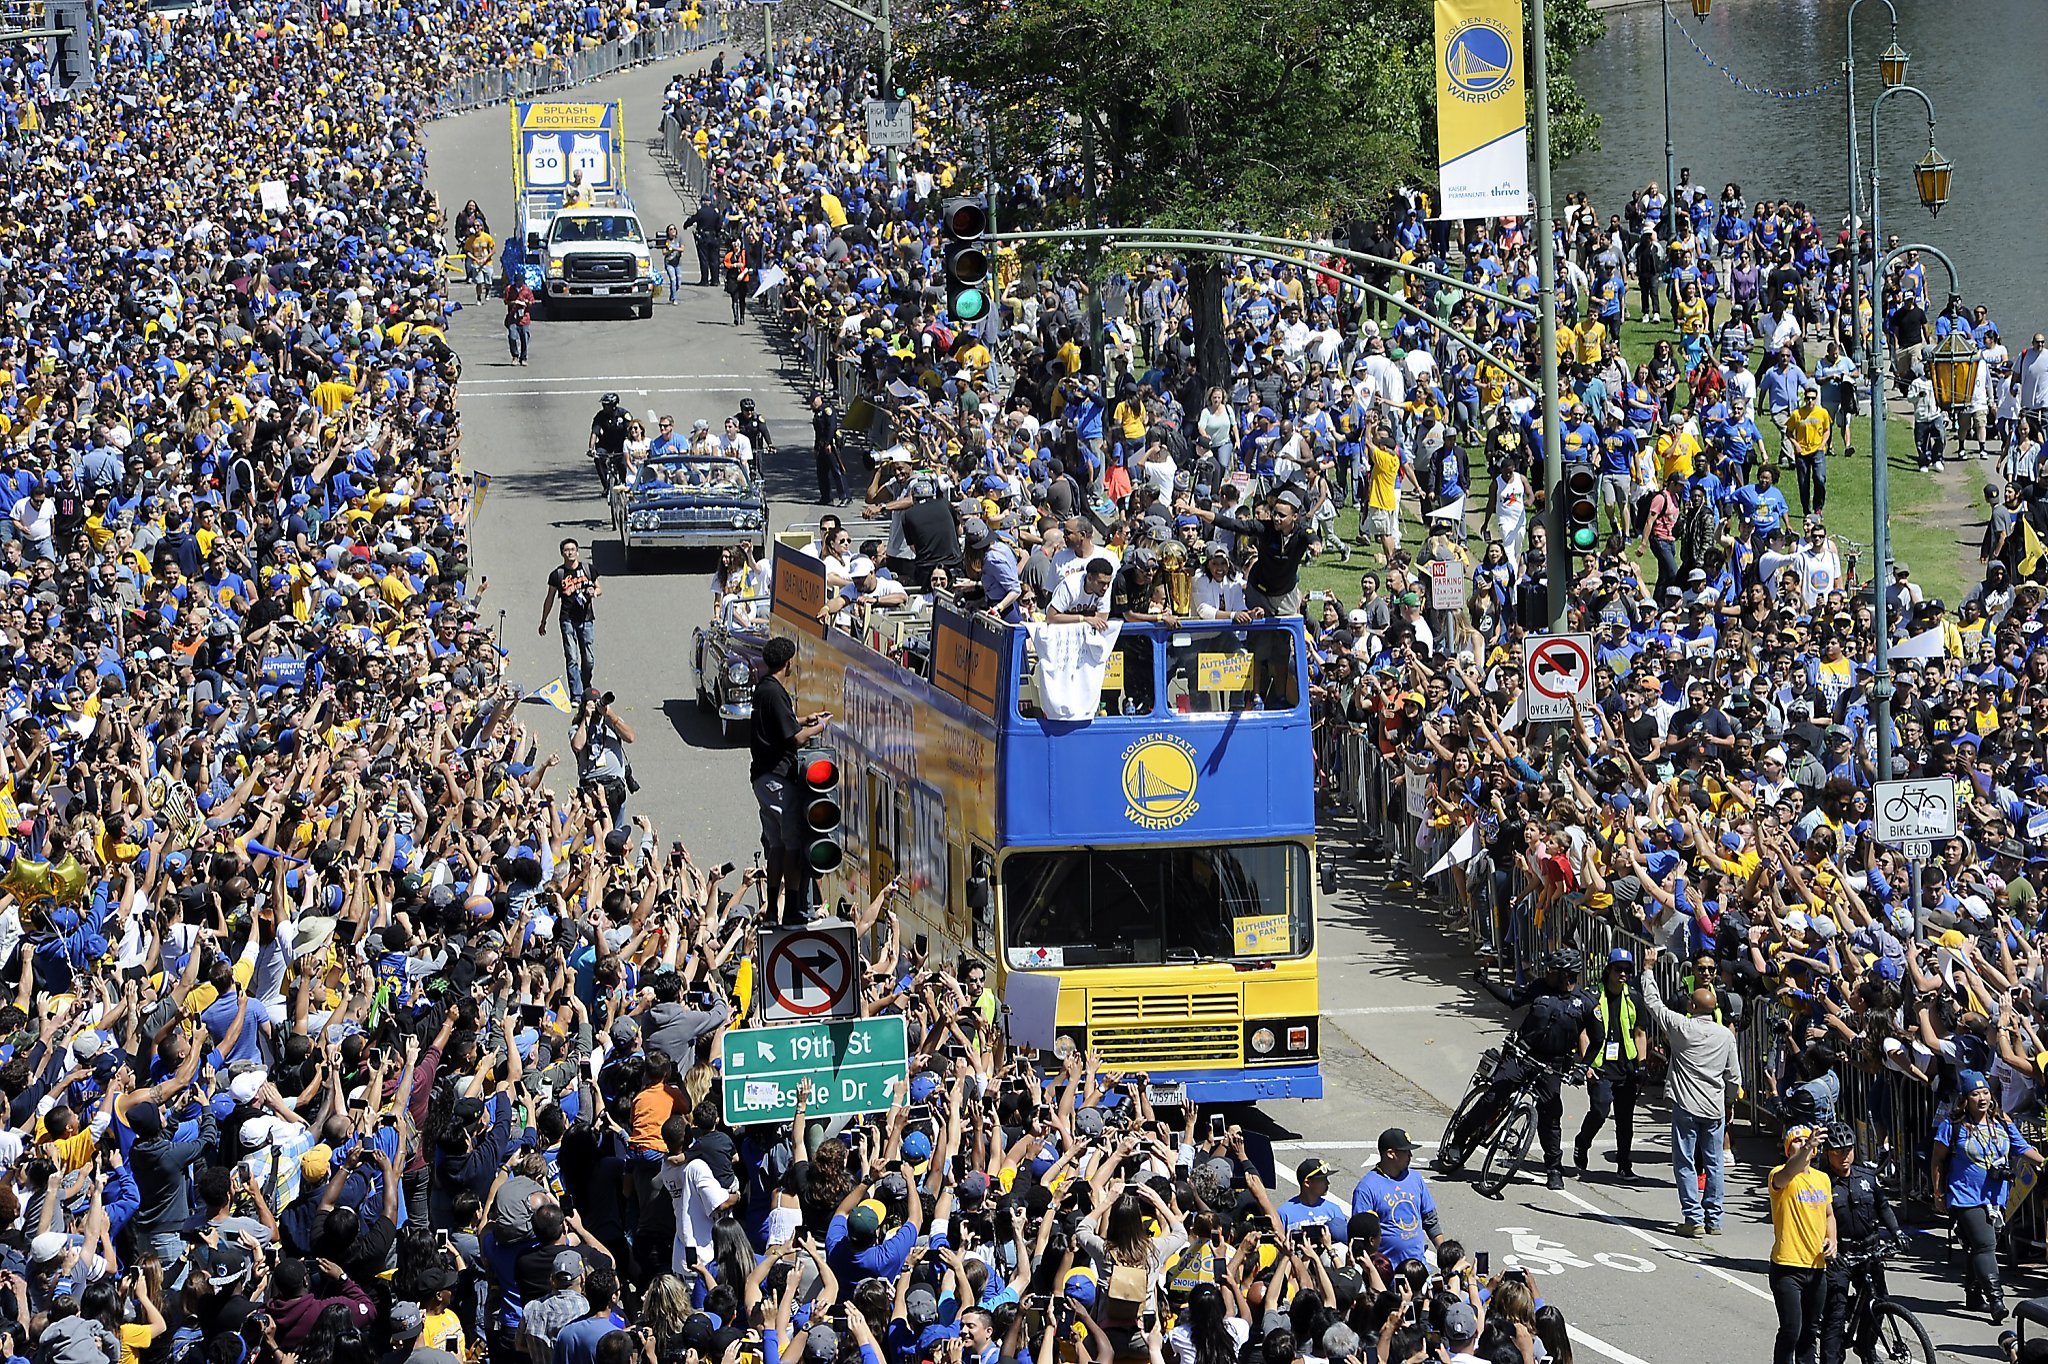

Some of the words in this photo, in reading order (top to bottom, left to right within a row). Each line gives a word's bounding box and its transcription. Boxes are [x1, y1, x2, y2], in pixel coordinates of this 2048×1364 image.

[1443, 17, 1481, 42] GOLDEN
[1485, 17, 1513, 38] STATE
[1447, 76, 1516, 104] WARRIORS
[543, 106, 588, 115] SPLASH
[536, 115, 596, 124] BROTHERS
[875, 118, 904, 128] MUST
[871, 131, 888, 140] TURN
[890, 130, 909, 139] RIGHT
[535, 157, 558, 169] 30
[580, 157, 594, 169] 11
[1491, 185, 1520, 197] thrive
[1433, 564, 1445, 576] NO
[1434, 576, 1462, 587] PARKING
[262, 662, 306, 670] AUTHENTIC
[1200, 654, 1252, 670] AUTHENTIC
[1223, 664, 1242, 674] FAN
[1530, 704, 1550, 715] OVER
[1121, 732, 1163, 760] GOLDEN
[1167, 733, 1198, 757] STATE
[1123, 799, 1201, 831] WARRIORS
[1890, 824, 1912, 837] BIKE
[1907, 843, 1929, 856] END
[1236, 916, 1287, 935] AUTHENTIC
[1259, 927, 1277, 937] FAN
[790, 1035, 836, 1061] 19th
[848, 1031, 872, 1055] St
[733, 1081, 830, 1113] Lesde
[841, 1079, 868, 1102] Dr
[1387, 1191, 1415, 1207] CITY
